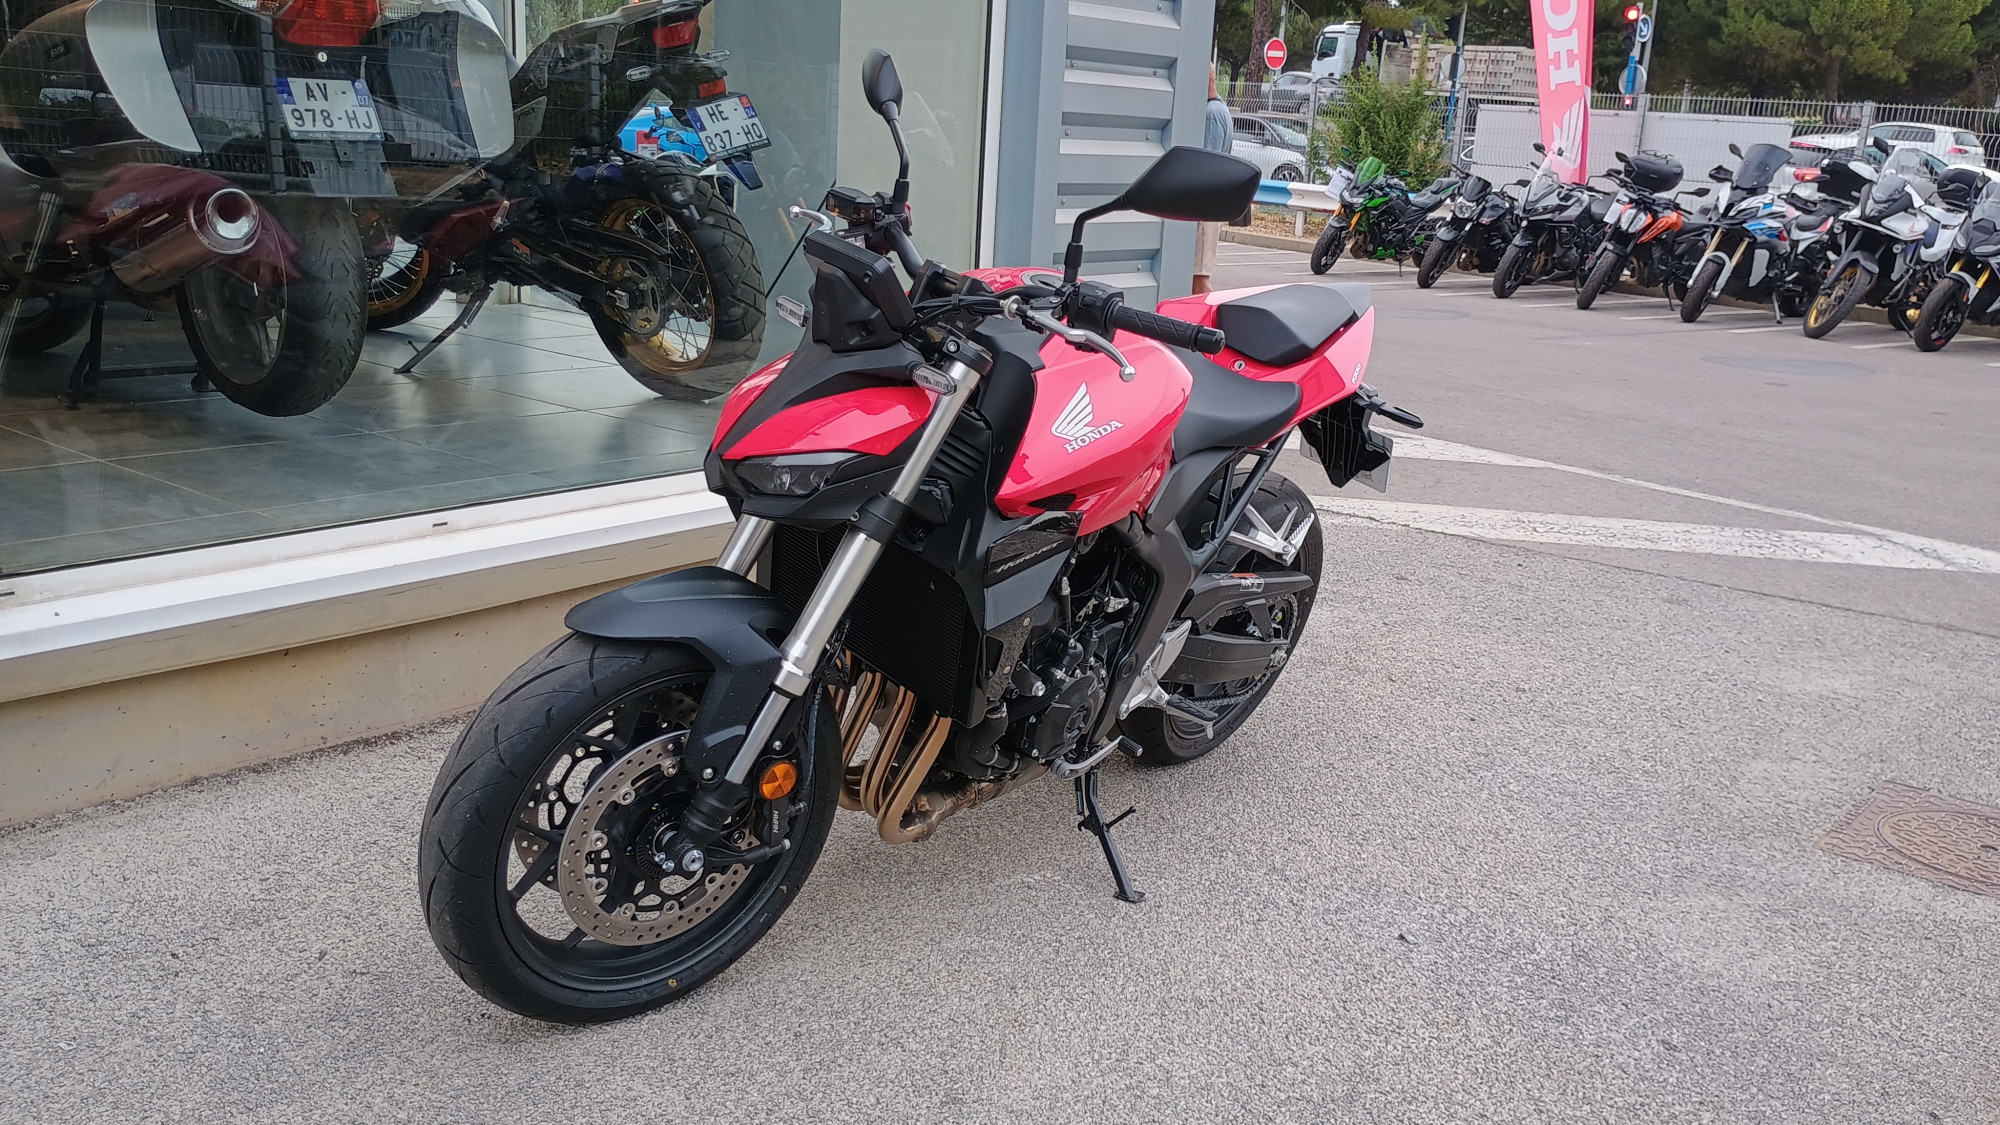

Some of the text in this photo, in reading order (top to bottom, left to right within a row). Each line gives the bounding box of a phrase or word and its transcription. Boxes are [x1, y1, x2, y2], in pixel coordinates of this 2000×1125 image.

[305, 82, 328, 102] AV
[358, 95, 369, 106] 07
[290, 108, 373, 130] 978-HJ
[705, 103, 729, 124] HE
[745, 107, 755, 118] 34
[704, 122, 763, 152] 837-HQ
[1063, 420, 1124, 454] HONDA
